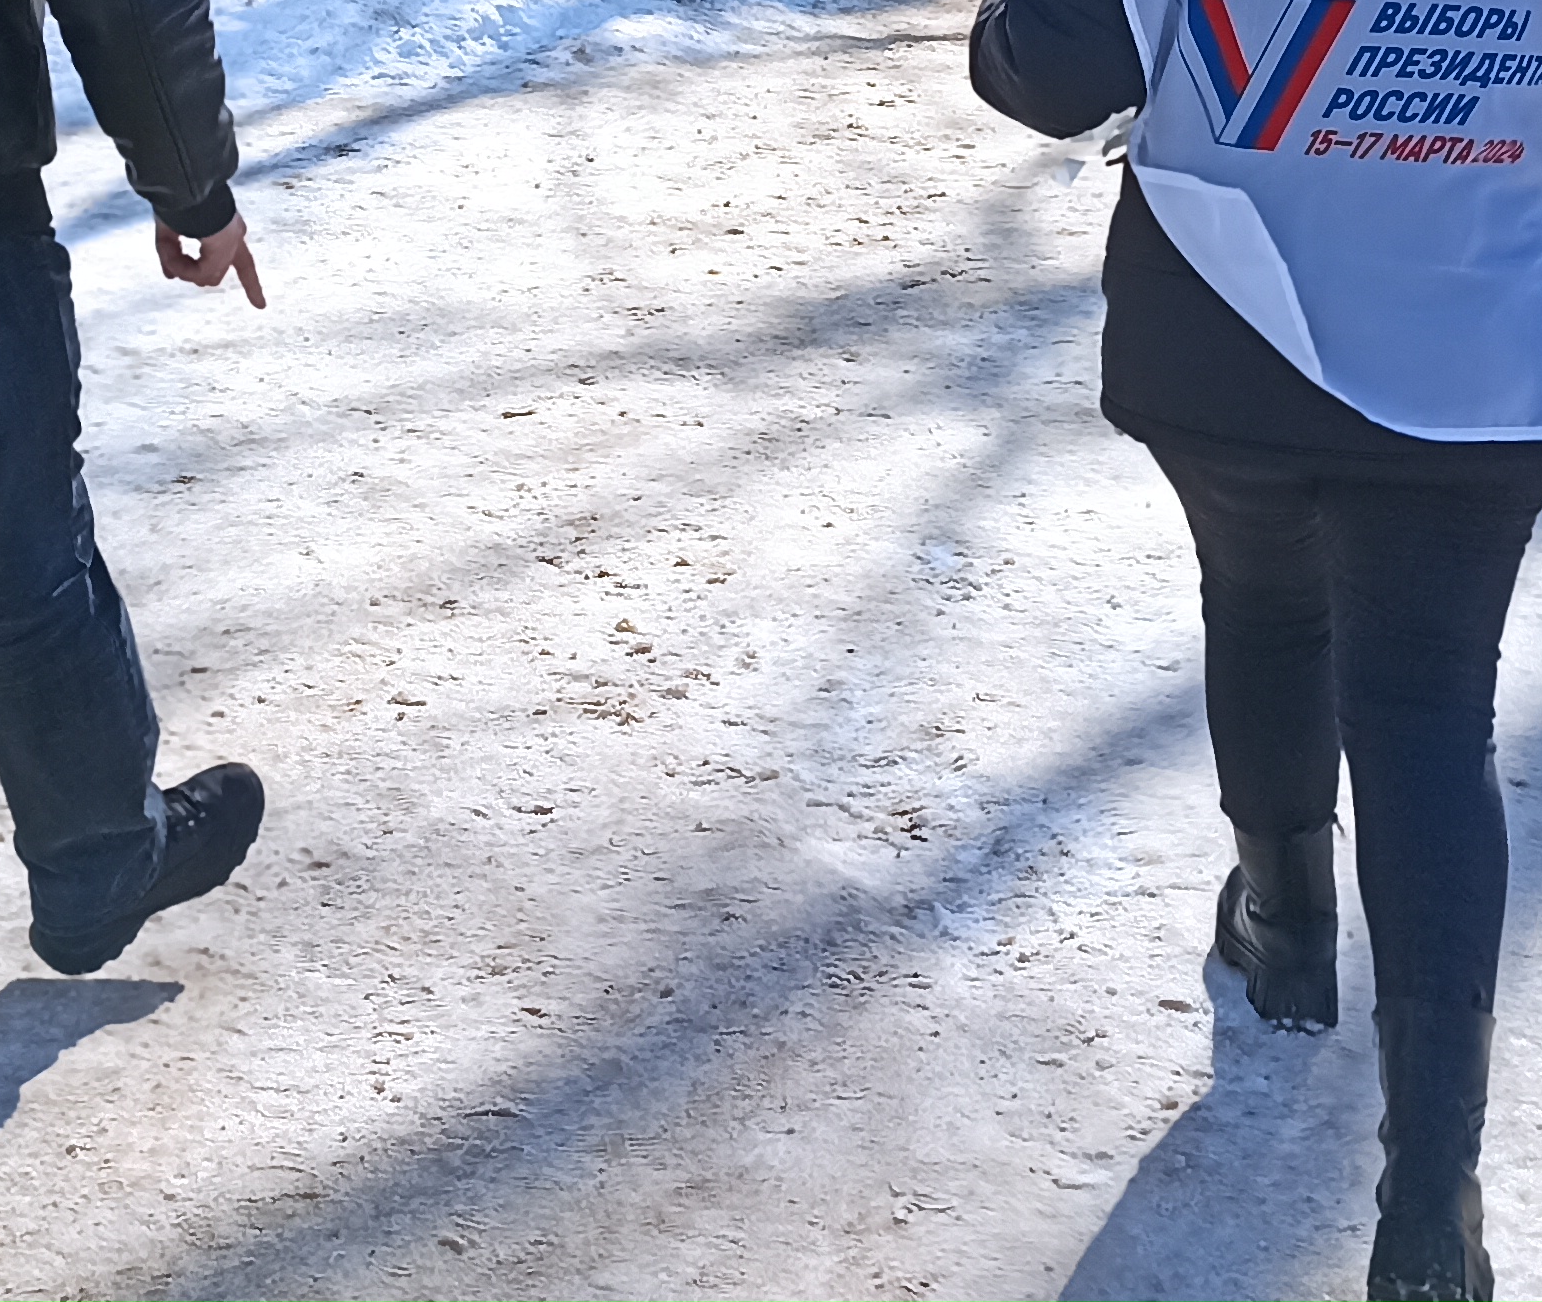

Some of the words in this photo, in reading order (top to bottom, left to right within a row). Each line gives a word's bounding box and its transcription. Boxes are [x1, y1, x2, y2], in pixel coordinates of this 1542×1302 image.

[1369, 1, 1532, 42] ВЫБОРЫ
[1322, 87, 1481, 126] РОССИИ
[1379, 133, 1475, 165] МАРТА
[1470, 139, 1525, 165] 2024
